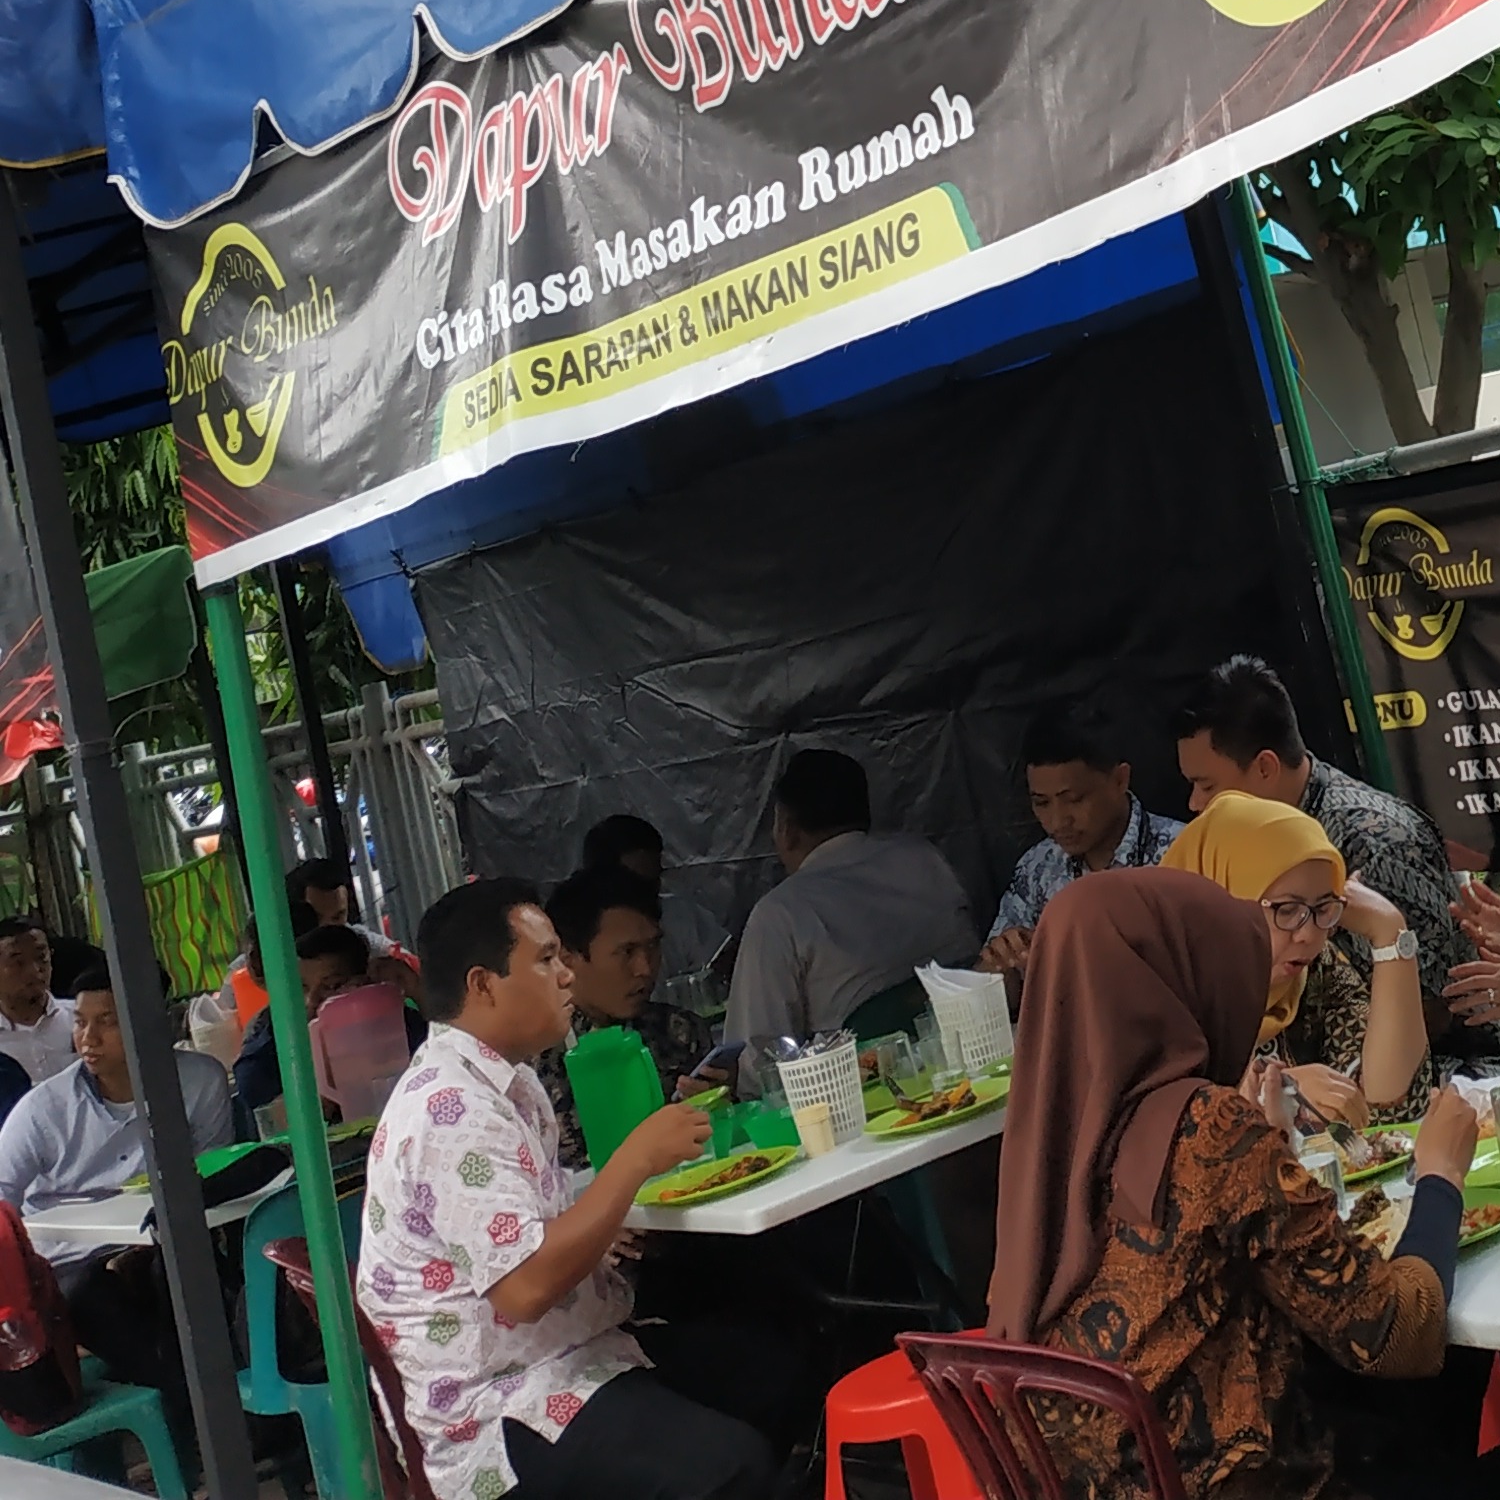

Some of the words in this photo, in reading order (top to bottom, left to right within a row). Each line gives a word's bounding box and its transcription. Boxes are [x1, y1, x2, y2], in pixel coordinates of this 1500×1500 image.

[388, 42, 631, 246] Dapur
[416, 300, 493, 369] Cita
[489, 260, 593, 338] Rasa
[596, 181, 787, 296] Masakan
[798, 85, 975, 212] Rumah
[161, 335, 233, 411] Dapur
[241, 275, 338, 363] Bunda
[225, 252, 262, 289] 2005
[464, 370, 522, 429] SEDIA
[530, 313, 671, 398] SARAPAN
[679, 305, 699, 346] &
[702, 254, 809, 334] MAKAN
[818, 211, 921, 290] SIANG
[1341, 565, 1405, 610] apur
[1409, 550, 1494, 591] Bunda
